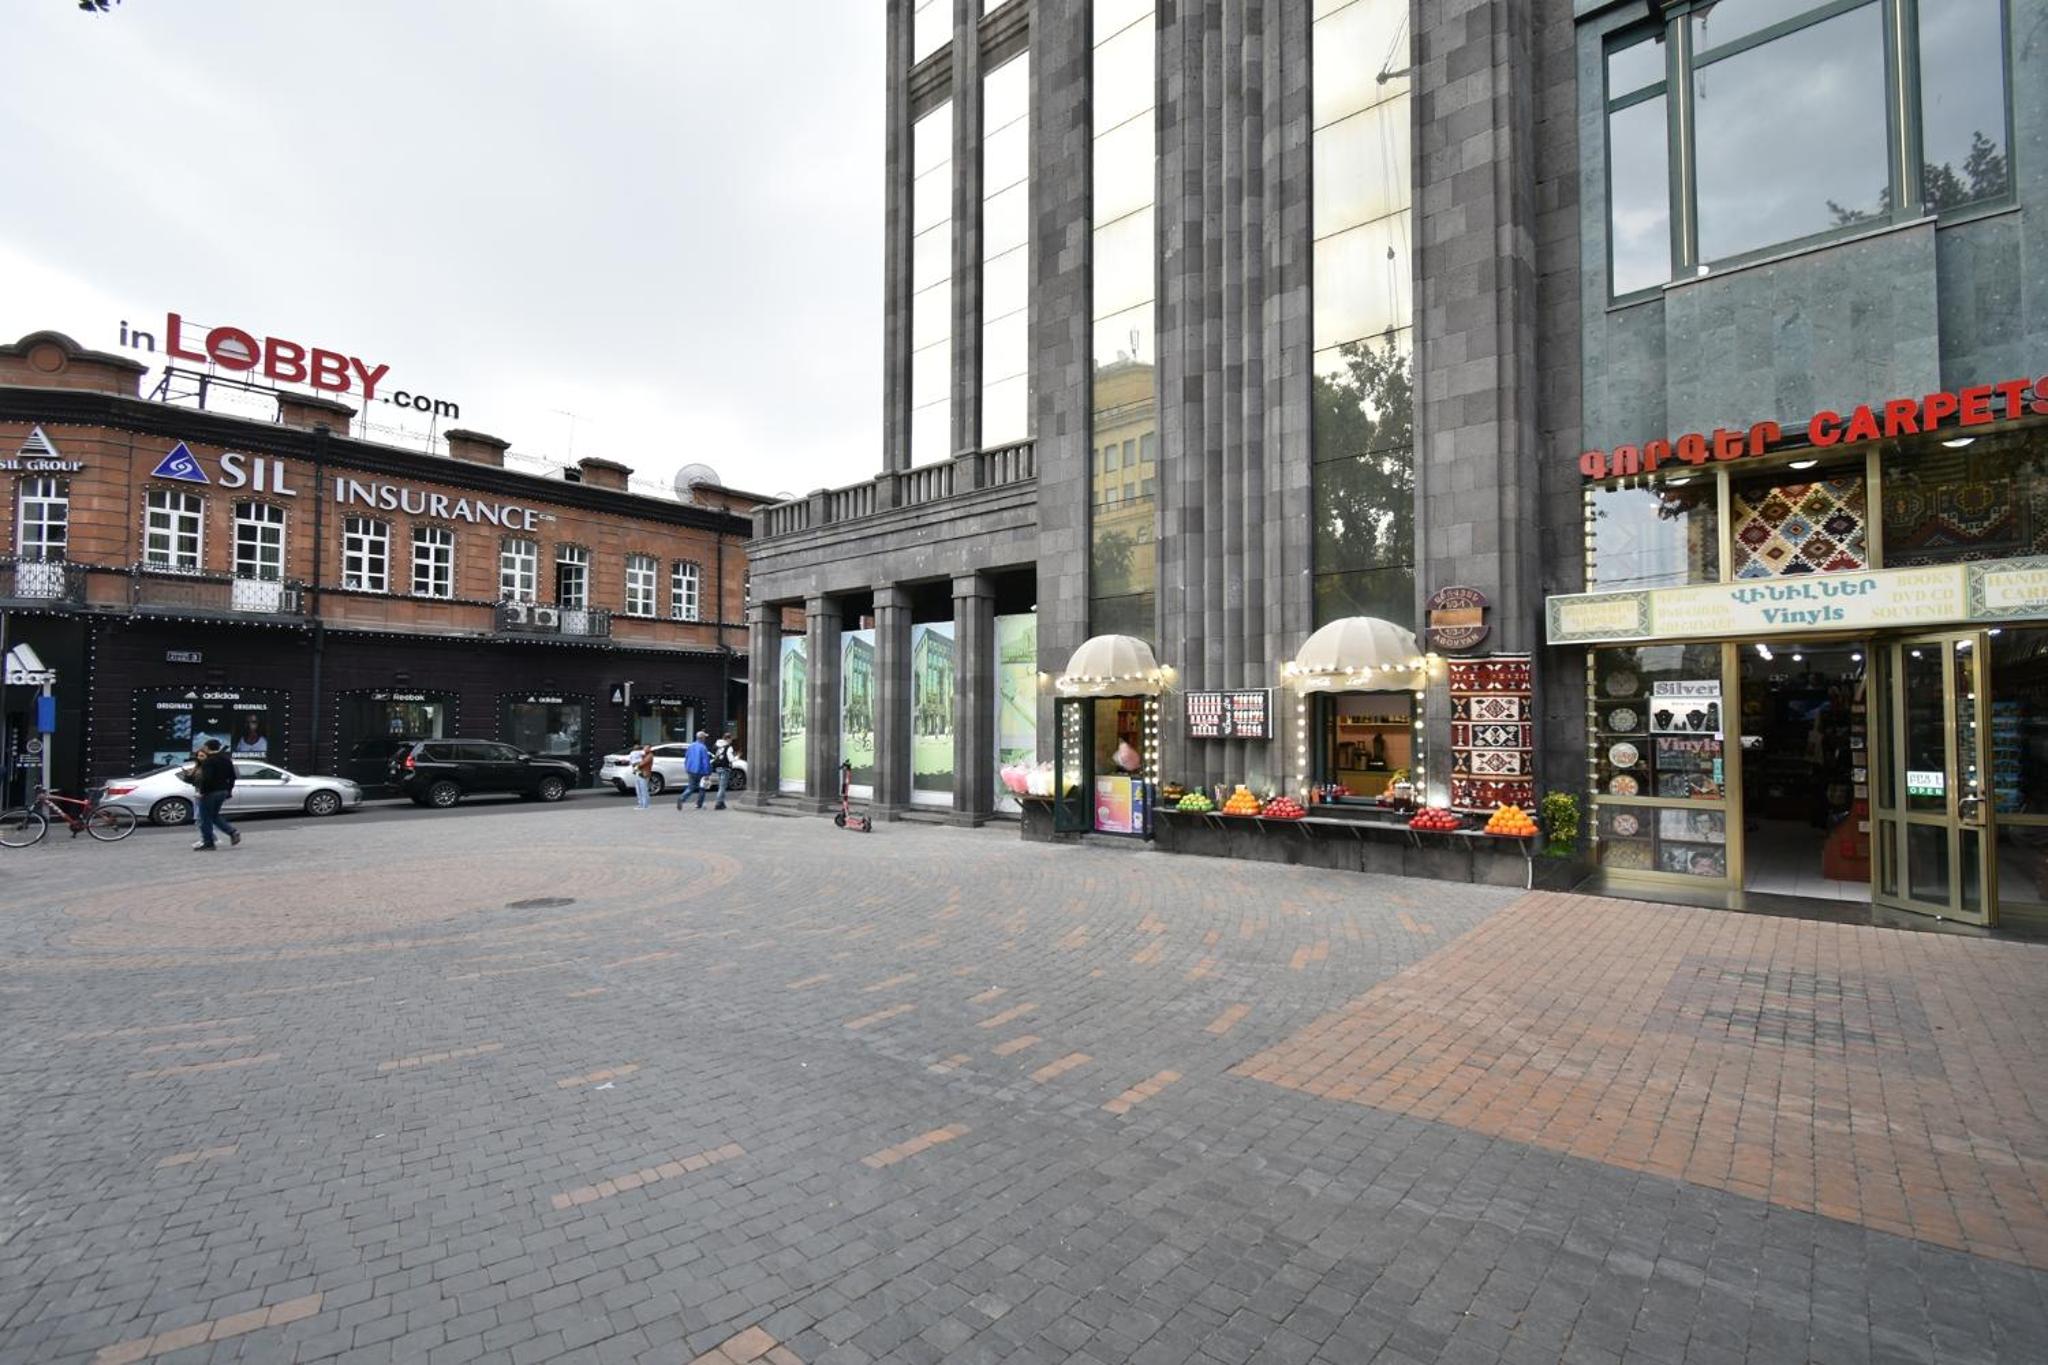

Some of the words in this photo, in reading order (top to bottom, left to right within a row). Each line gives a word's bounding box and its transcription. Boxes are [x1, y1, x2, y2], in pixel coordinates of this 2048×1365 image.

[1578, 421, 1782, 480] ԳՈՐԳԵՐ
[26, 459, 83, 471] GROUP
[219, 453, 297, 497] SIL
[335, 477, 539, 532] INSURANCE
[1731, 578, 1877, 604] ՎԻՆԻԼՆԵՐ
[1761, 605, 1845, 625] Vinyls
[1433, 633, 1479, 647] ABOVYAN
[202, 692, 240, 700] adidas
[1655, 682, 1719, 696] Silver
[1657, 736, 1721, 753] Vinyls
[1909, 787, 1943, 796] OPEN
